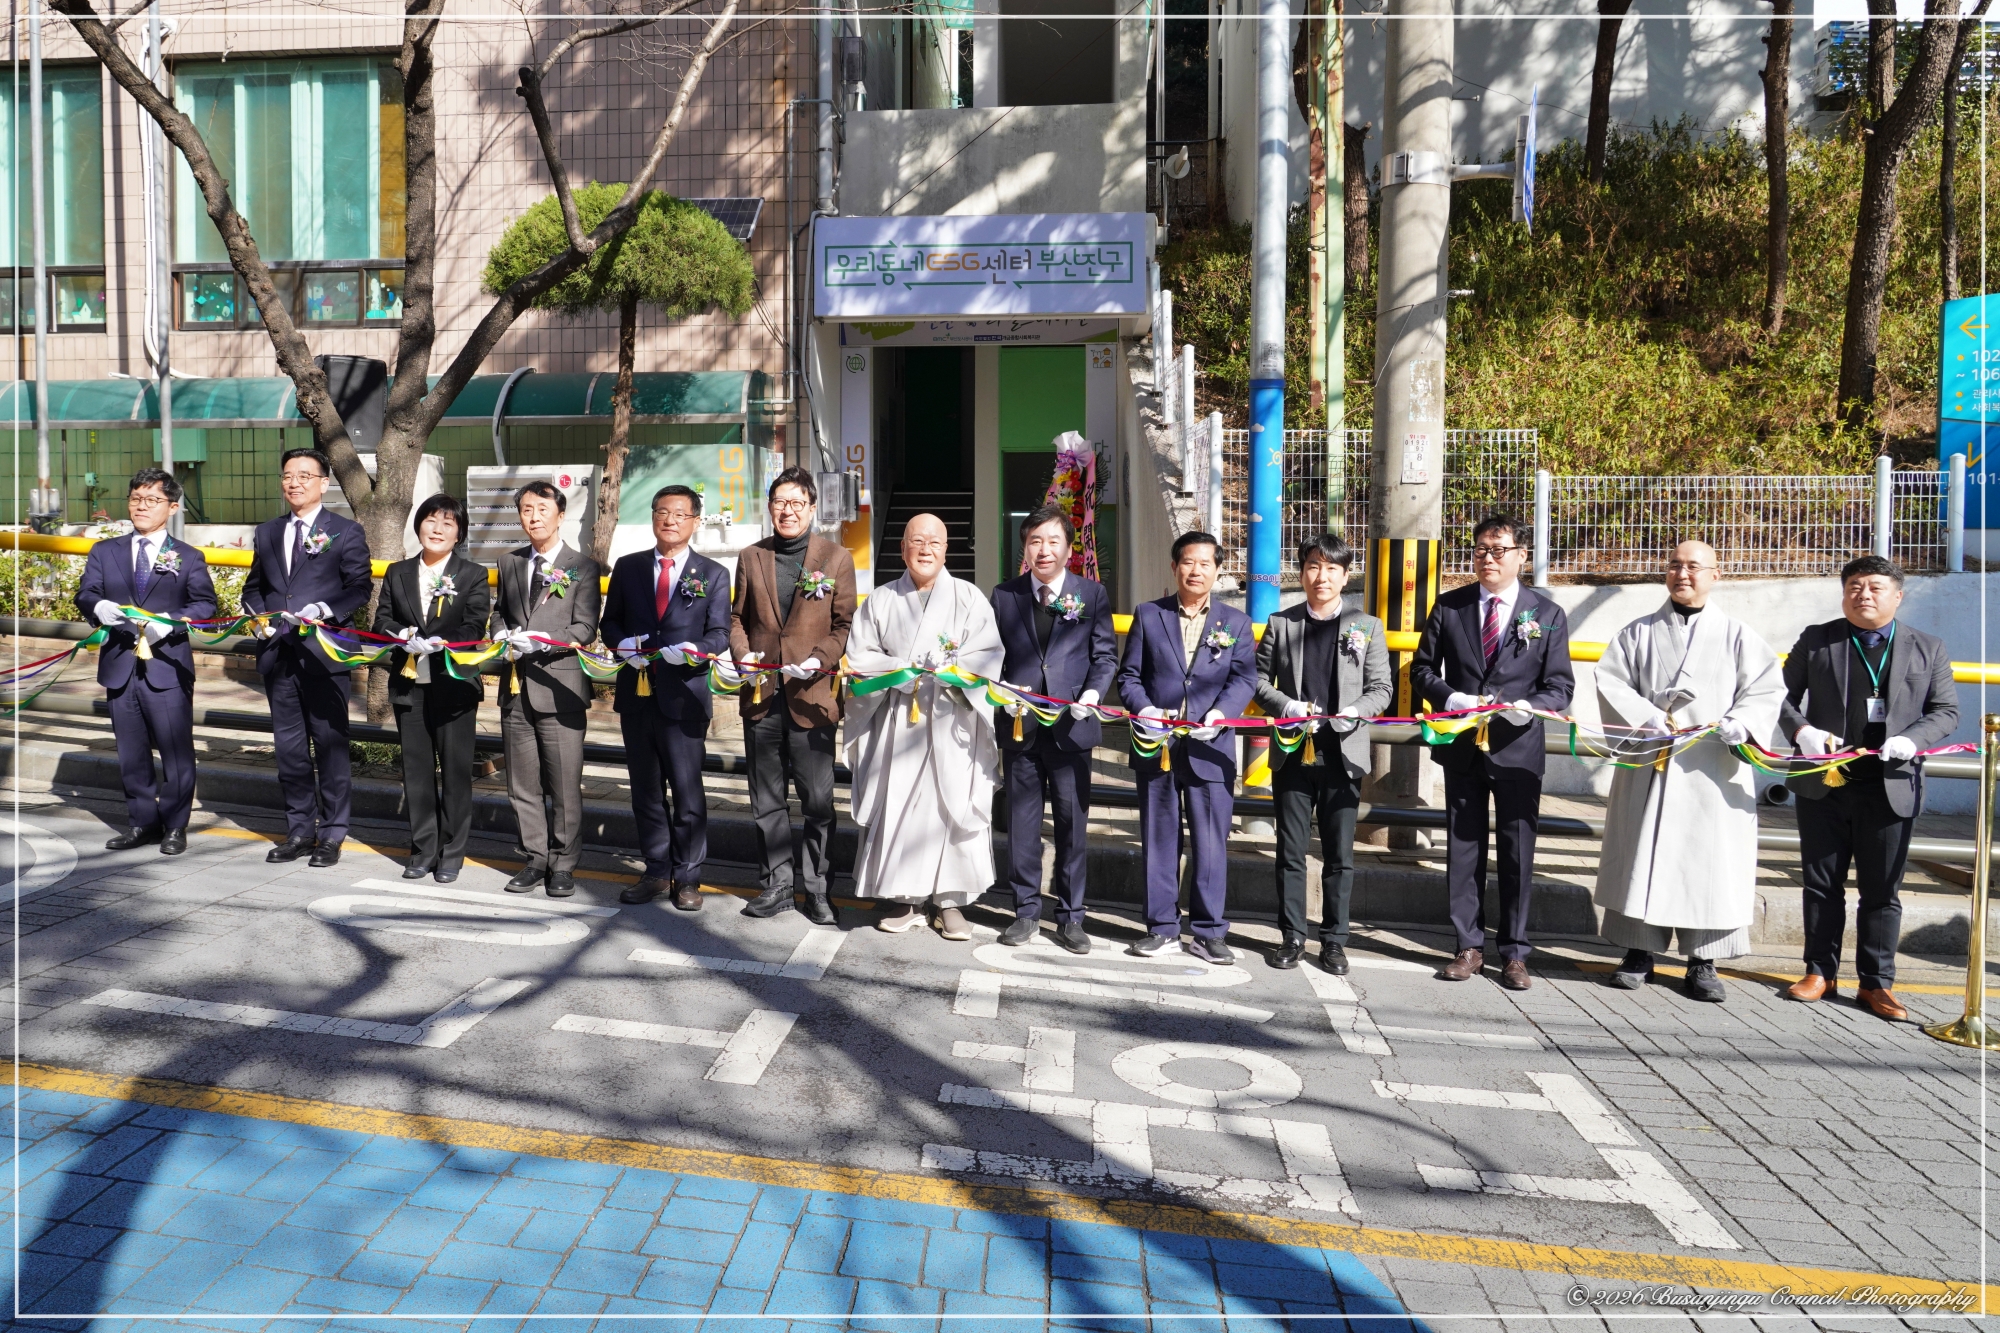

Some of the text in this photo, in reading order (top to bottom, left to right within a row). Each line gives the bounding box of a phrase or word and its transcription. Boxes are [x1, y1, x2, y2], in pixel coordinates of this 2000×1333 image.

[1037, 247, 1124, 277] 부산진구
[1972, 350, 2000, 363] 102
[1971, 368, 2000, 381] 106
[573, 476, 589, 487] LG
[1968, 472, 2000, 485] 101
[1405, 559, 1415, 591] 위험
